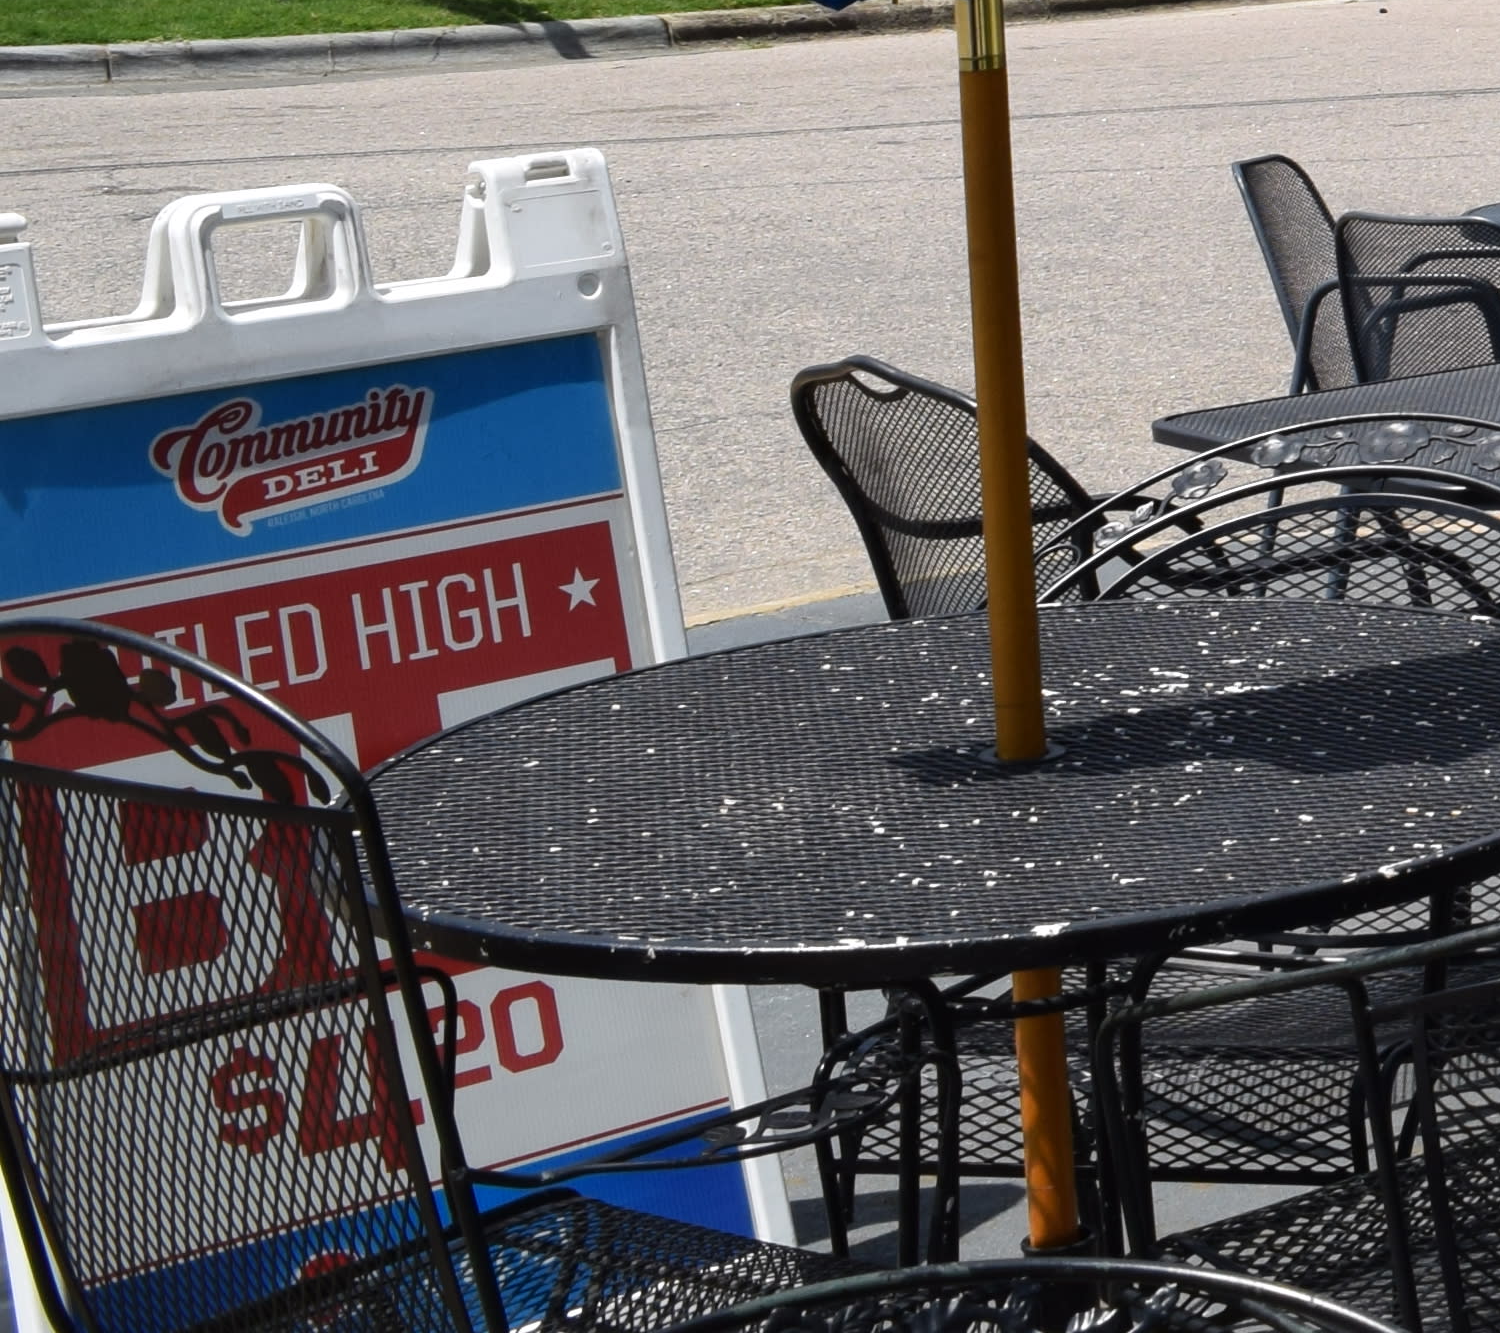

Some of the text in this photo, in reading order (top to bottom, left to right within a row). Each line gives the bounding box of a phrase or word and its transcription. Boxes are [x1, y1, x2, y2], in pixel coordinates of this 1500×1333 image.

[153, 386, 426, 504] Community
[262, 450, 380, 500] DELI
[351, 561, 533, 671] HIGH
